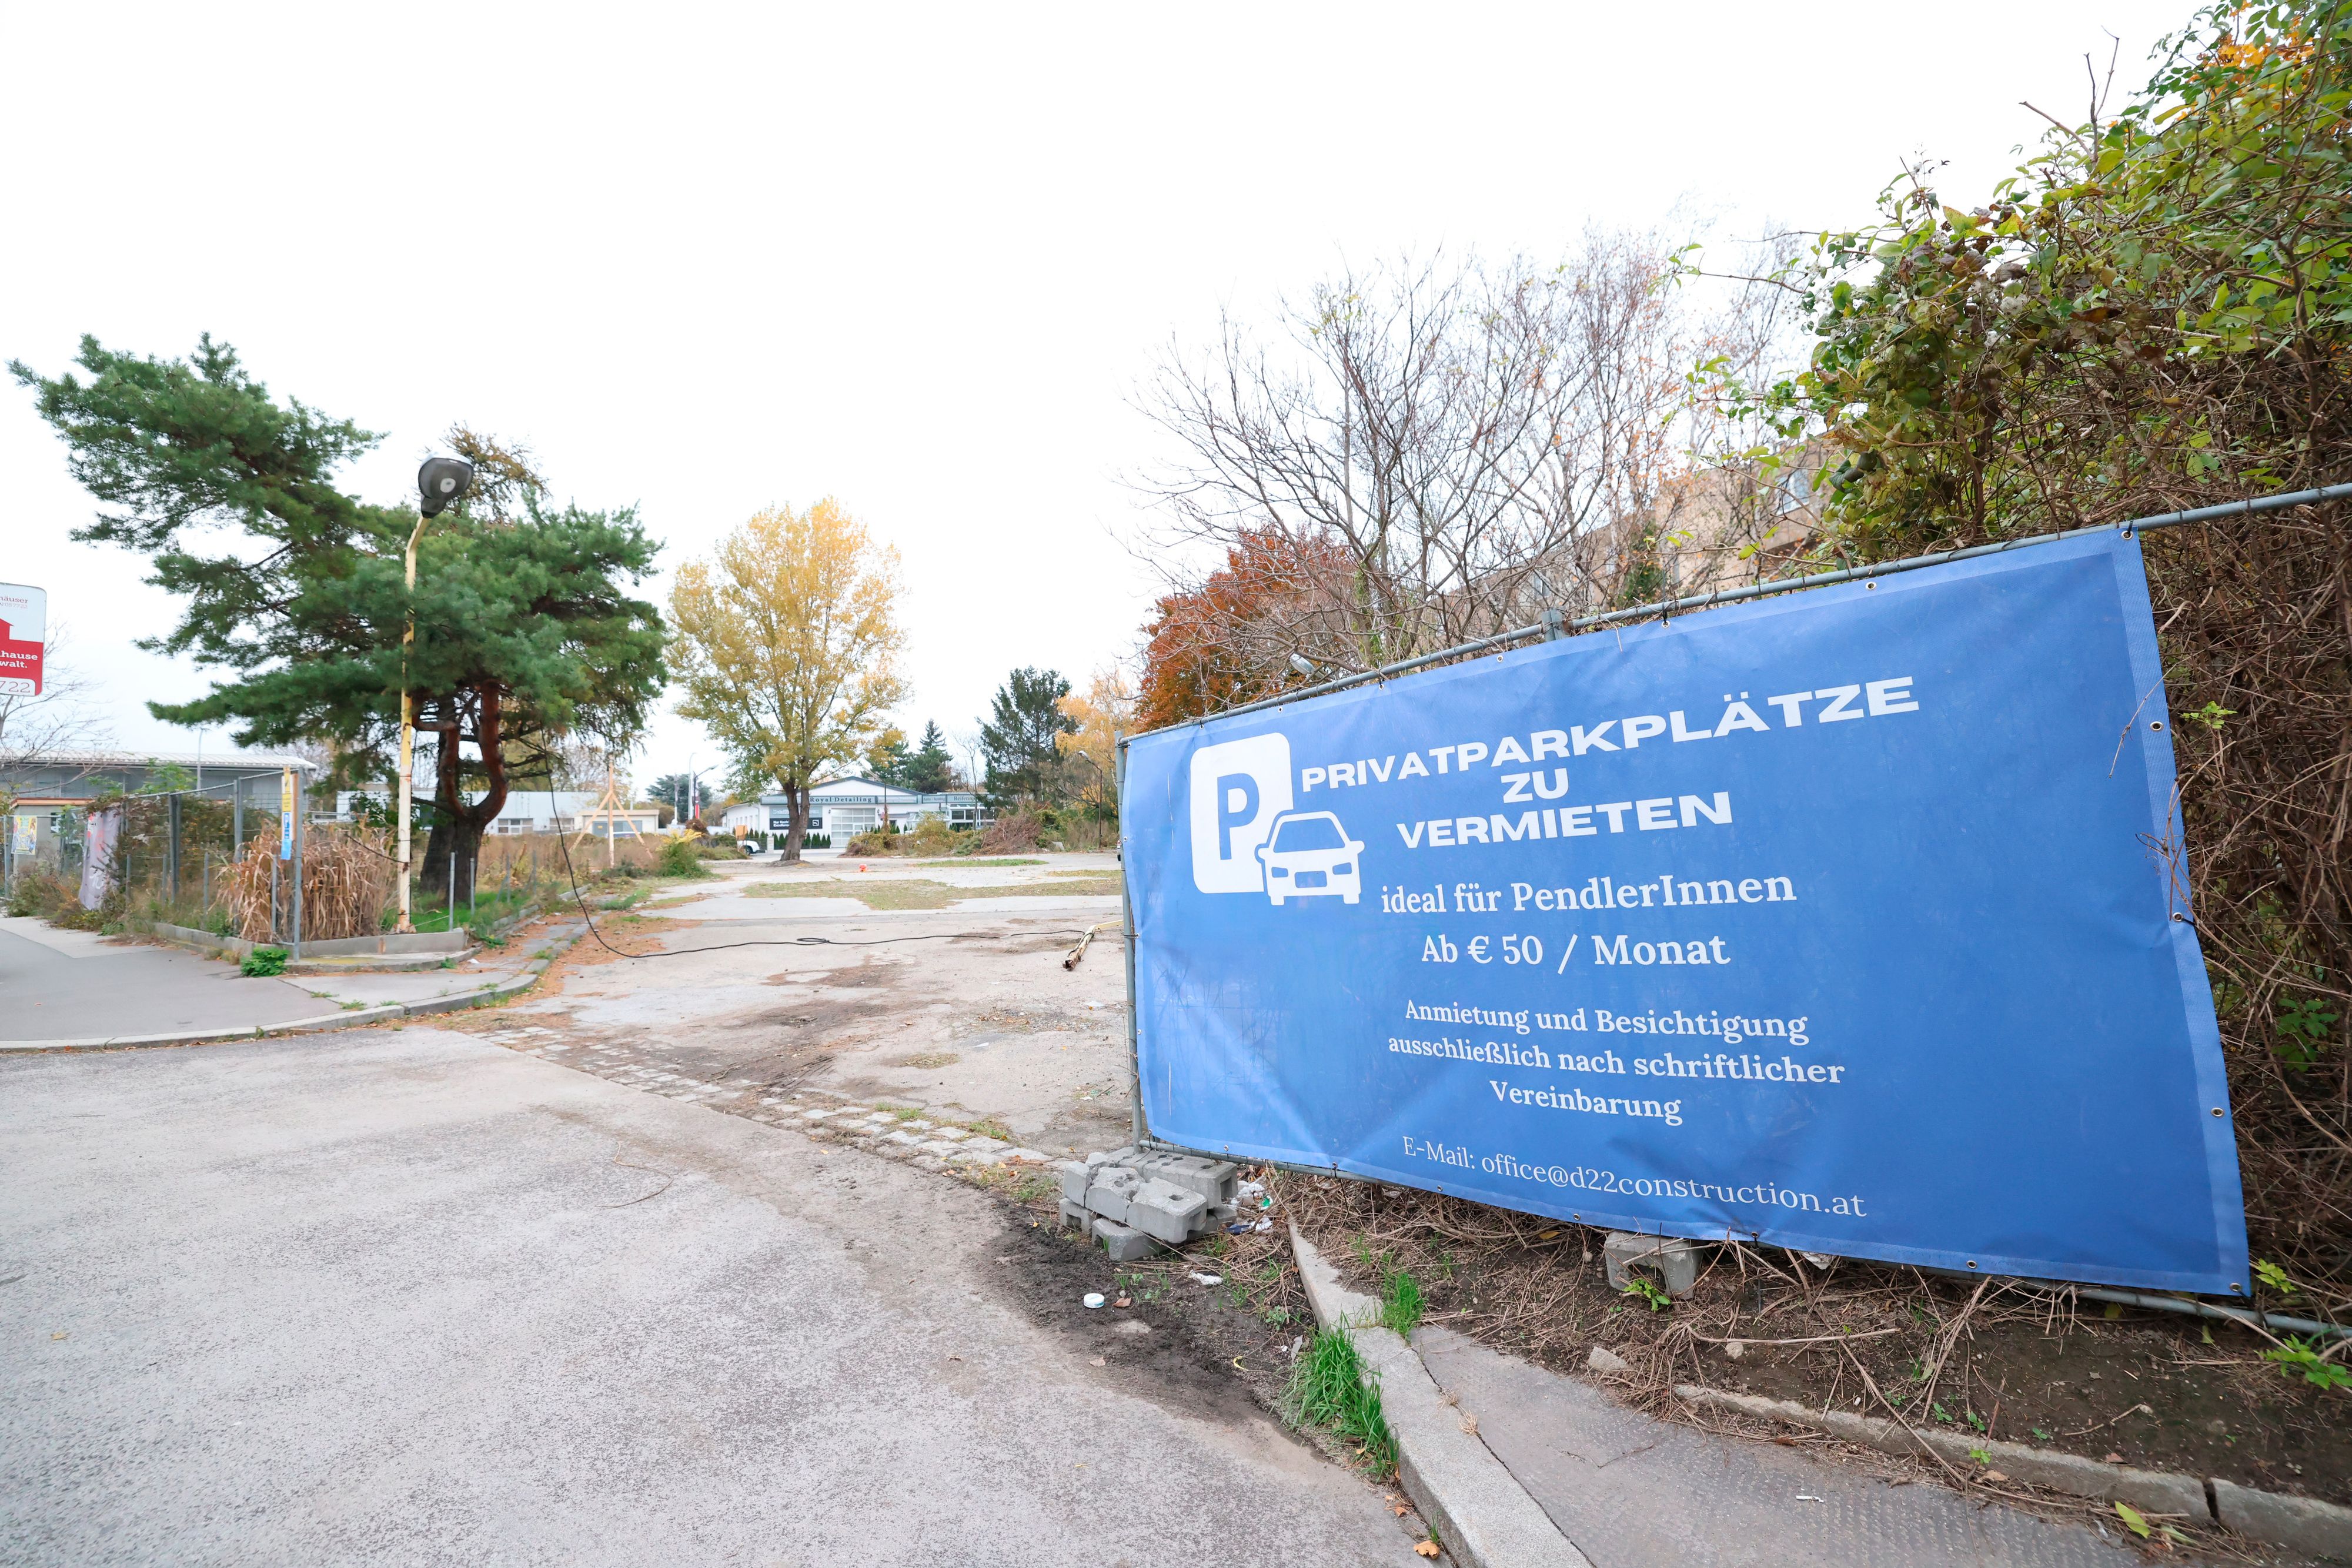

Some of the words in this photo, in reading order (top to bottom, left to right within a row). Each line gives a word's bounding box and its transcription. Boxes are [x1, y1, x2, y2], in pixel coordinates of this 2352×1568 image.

[0, 650, 38, 660] hause
[1301, 676, 1919, 793] PRIVATPARKPLÄTZE
[1501, 768, 1569, 804] ZU
[1217, 773, 1259, 860] P
[1396, 791, 1732, 848] VERMIETEN
[1381, 884, 1448, 913] ideal
[1454, 882, 1502, 912] für
[1511, 875, 1797, 911] PendlerInnen
[1422, 934, 1458, 963] Ab
[1467, 935, 1493, 964] €
[1502, 934, 1544, 965] 50
[1558, 934, 1578, 975] /
[1591, 935, 1732, 965] Monat
[1405, 999, 1531, 1035] Anmietung
[1535, 1008, 1589, 1031] und
[1595, 1009, 1810, 1047] Besichtigung
[1388, 1037, 1552, 1068] ausschließlich
[1558, 1050, 1626, 1075] nach
[1633, 1052, 1845, 1084] schriftlicher
[1489, 1081, 1683, 1126] Vereinbarung
[1403, 1136, 1475, 1169] E-Mail:
[1482, 1152, 1867, 1217] office@d22construction.at
